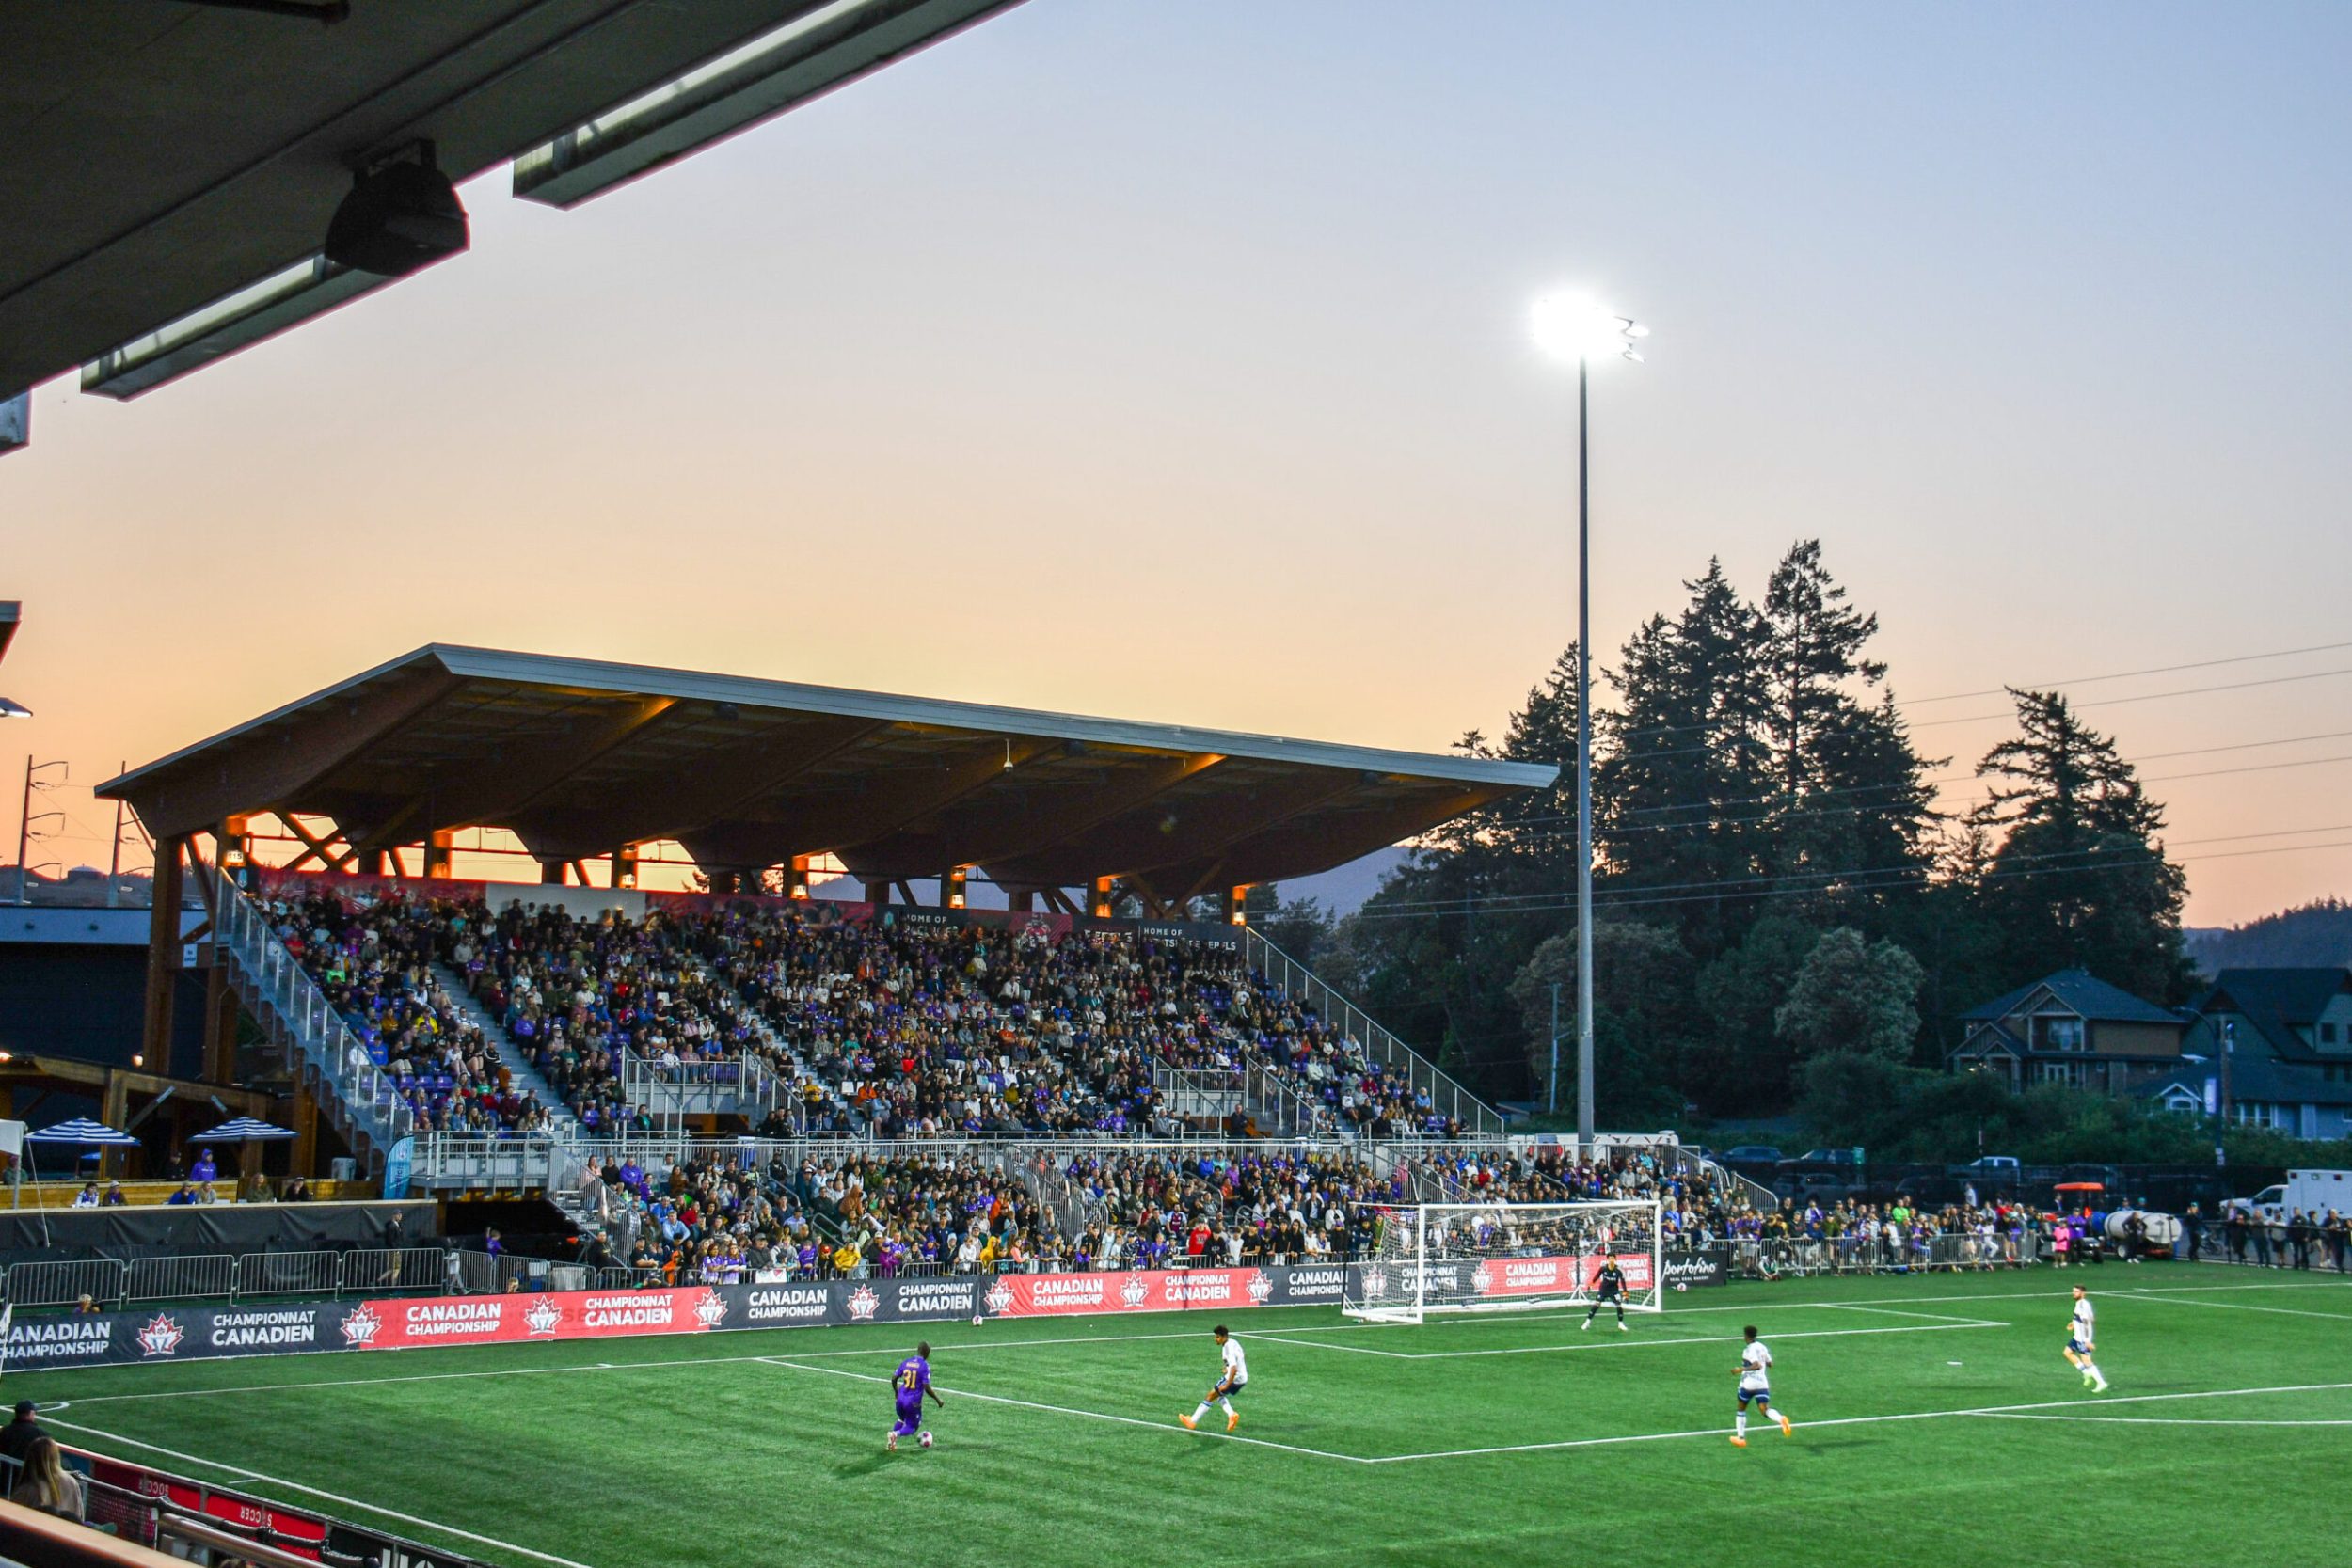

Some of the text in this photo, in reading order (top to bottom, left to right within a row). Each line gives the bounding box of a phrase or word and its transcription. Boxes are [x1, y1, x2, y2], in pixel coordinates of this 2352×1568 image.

[1506, 1263, 1556, 1275] CANADIAN
[1661, 1257, 1716, 1282] portofino
[1033, 1278, 1103, 1294] CANADIAN
[1166, 1275, 1230, 1286] CHAMPIONNAT
[1506, 1275, 1556, 1287] CHAMPIONSHIP
[899, 1283, 973, 1295] CHAMPIONNAT
[1166, 1285, 1230, 1300] CANADIEN
[586, 1295, 673, 1309] CHAMPIONNAT
[749, 1289, 827, 1306] CANADIAN
[898, 1295, 972, 1311] CANADIEN
[1033, 1294, 1103, 1306] CHAMPIONSHIP
[214, 1311, 315, 1326] CHAMPIONNAT
[407, 1303, 501, 1322] CANADIAN
[585, 1308, 672, 1326] CANADIEN
[749, 1306, 826, 1319] CHAMPIONSHIP
[212, 1325, 315, 1346] CANADIEN
[406, 1321, 500, 1335] CHAMPIONSHIP
[903, 1370, 917, 1388] 31
[240, 1505, 272, 1527] SCCER
